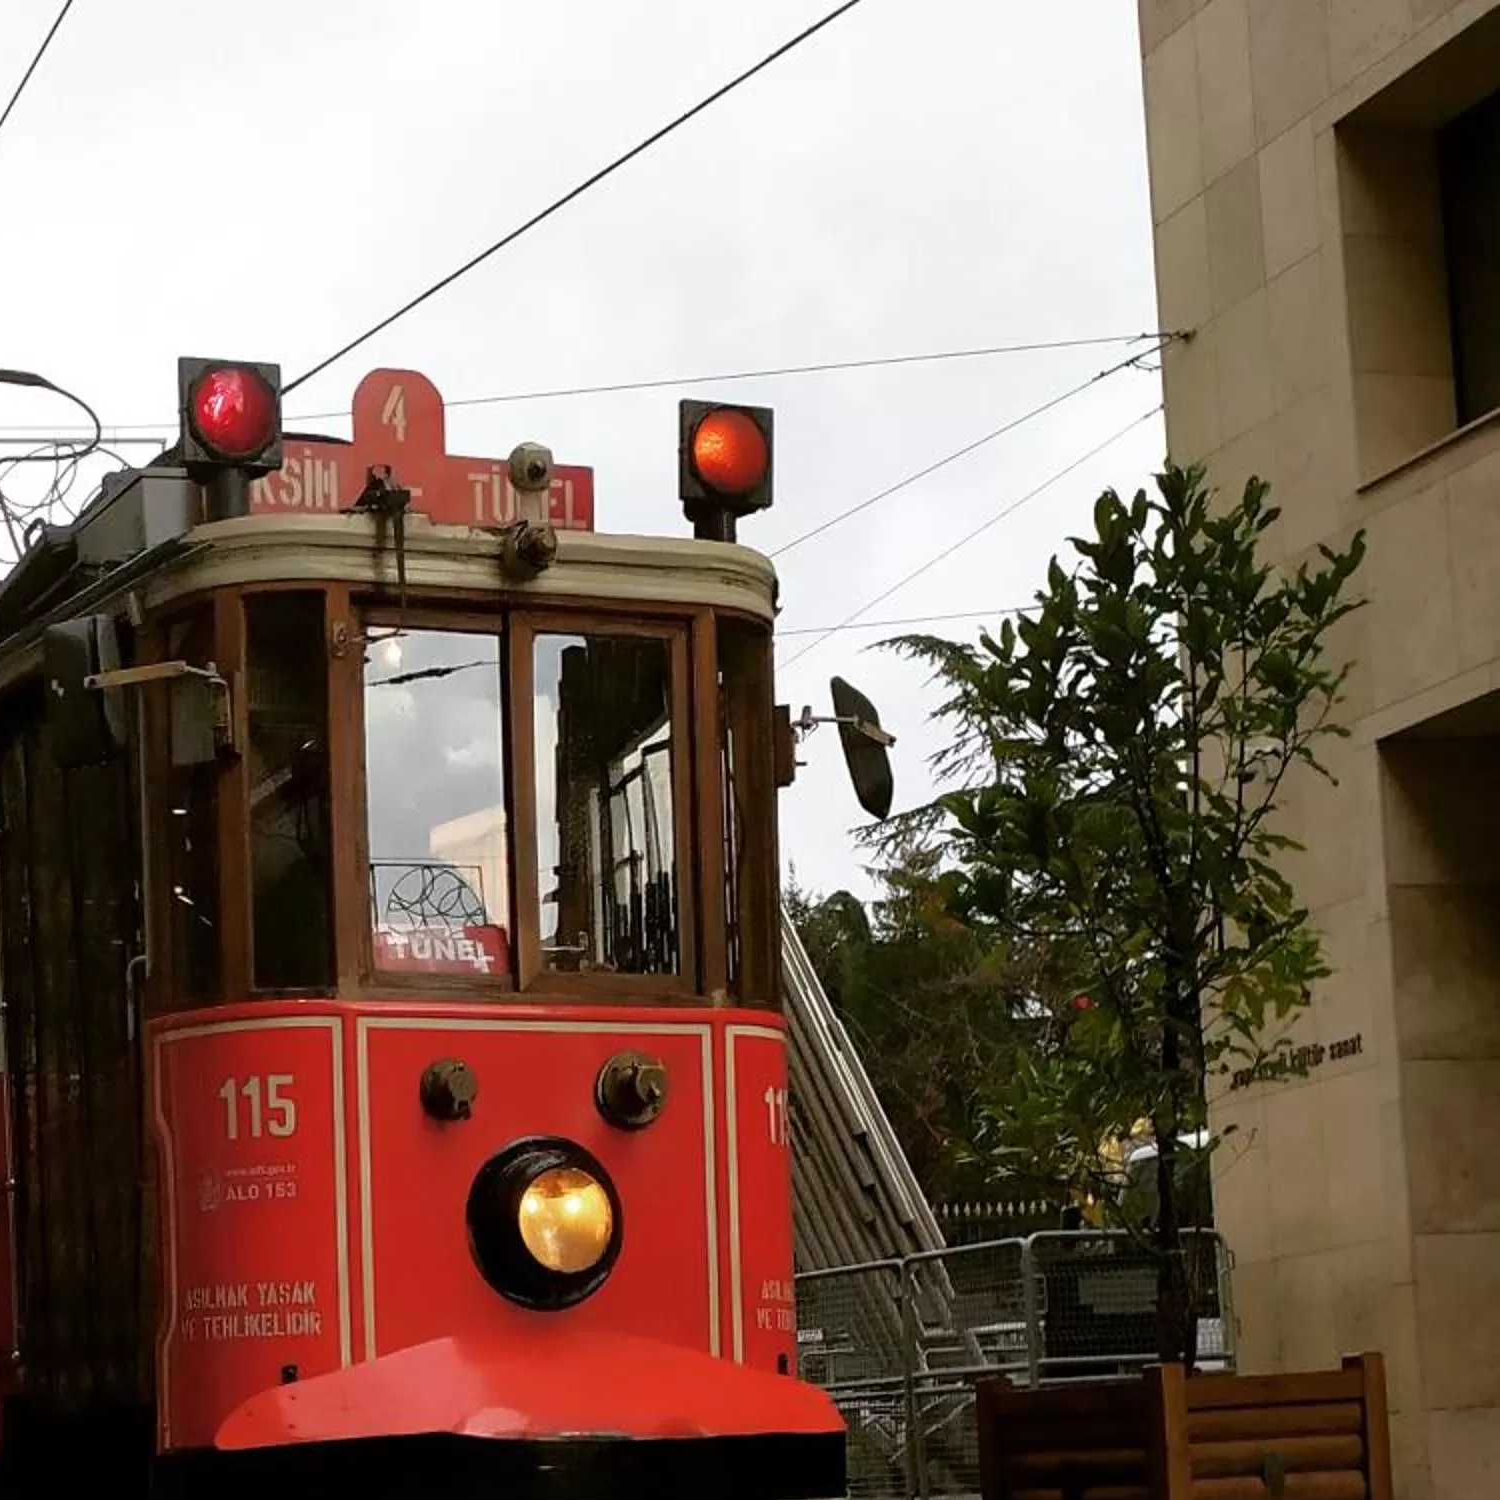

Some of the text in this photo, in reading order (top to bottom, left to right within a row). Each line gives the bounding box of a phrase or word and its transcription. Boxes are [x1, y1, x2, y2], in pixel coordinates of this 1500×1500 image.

[381, 385, 408, 443] 4
[253, 449, 588, 530] KSİM TÜEL
[219, 1074, 296, 1140] 115
[225, 1181, 297, 1201] ALO 153
[257, 1281, 315, 1306] YASAK
